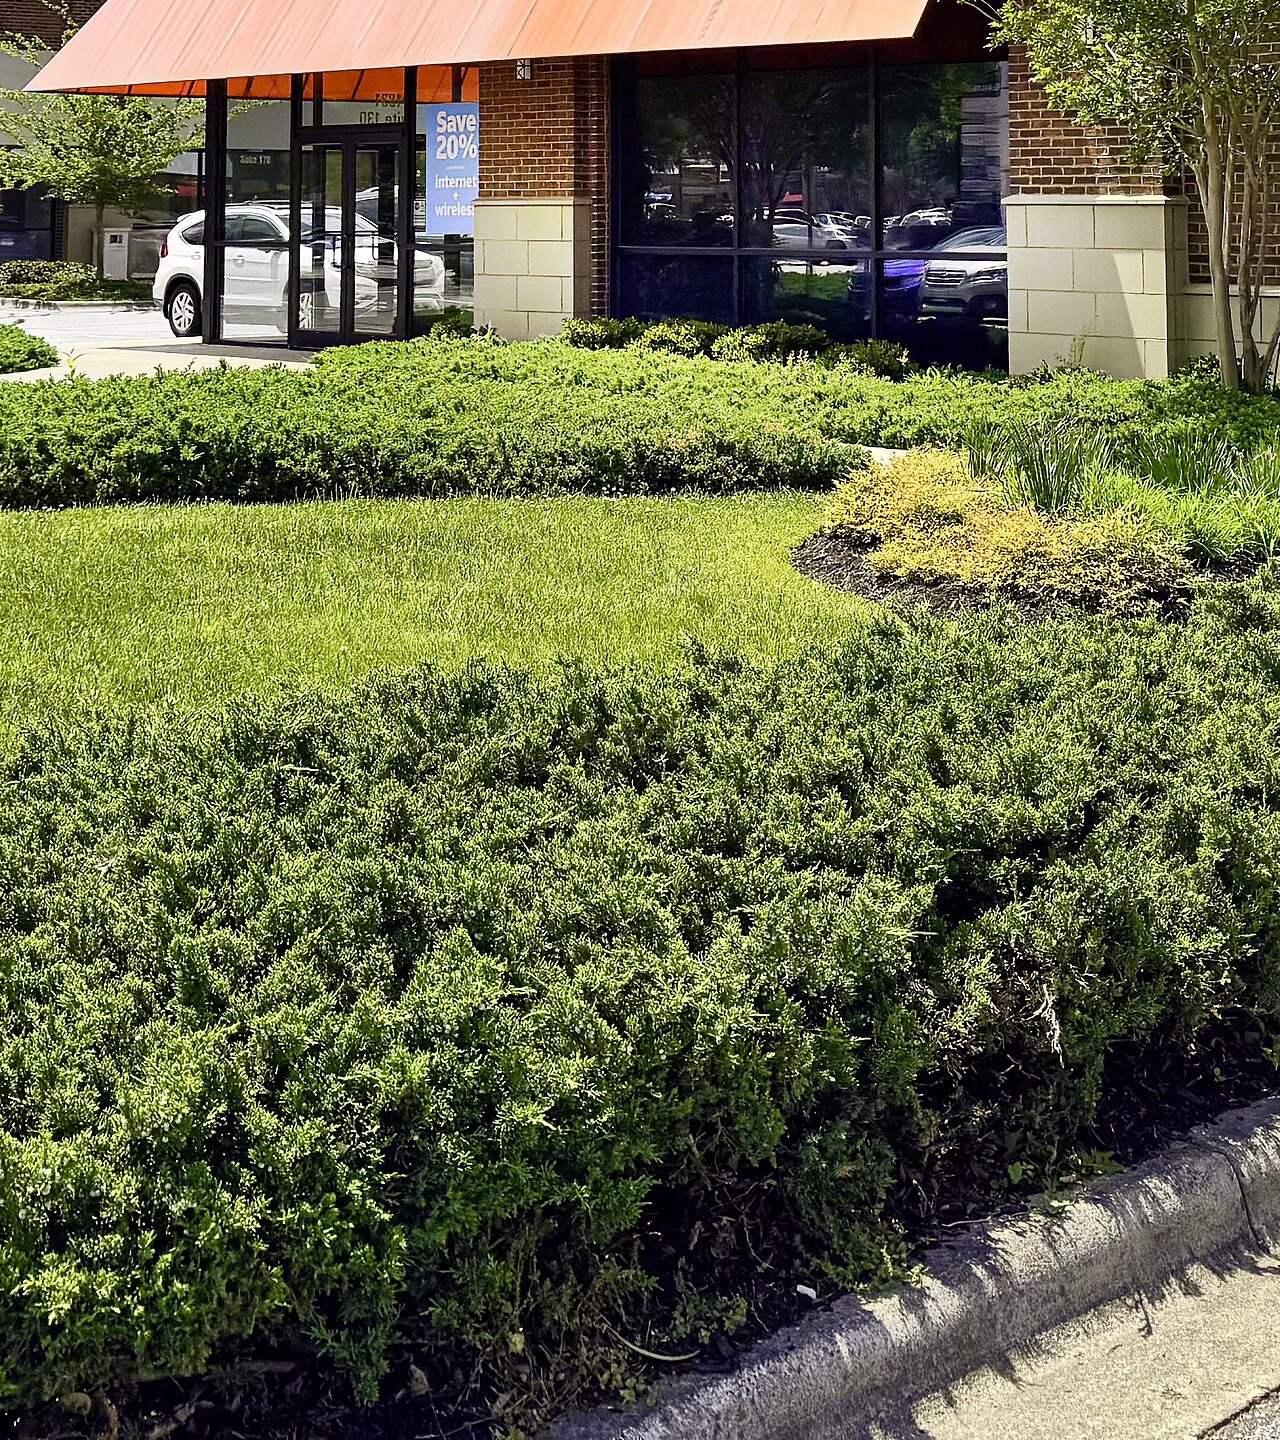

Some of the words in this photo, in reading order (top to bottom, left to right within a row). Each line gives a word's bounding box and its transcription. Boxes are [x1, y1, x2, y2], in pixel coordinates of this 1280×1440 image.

[436, 110, 477, 133] Save
[436, 134, 478, 160] 20%
[435, 174, 477, 189] internet
[452, 191, 460, 200] +
